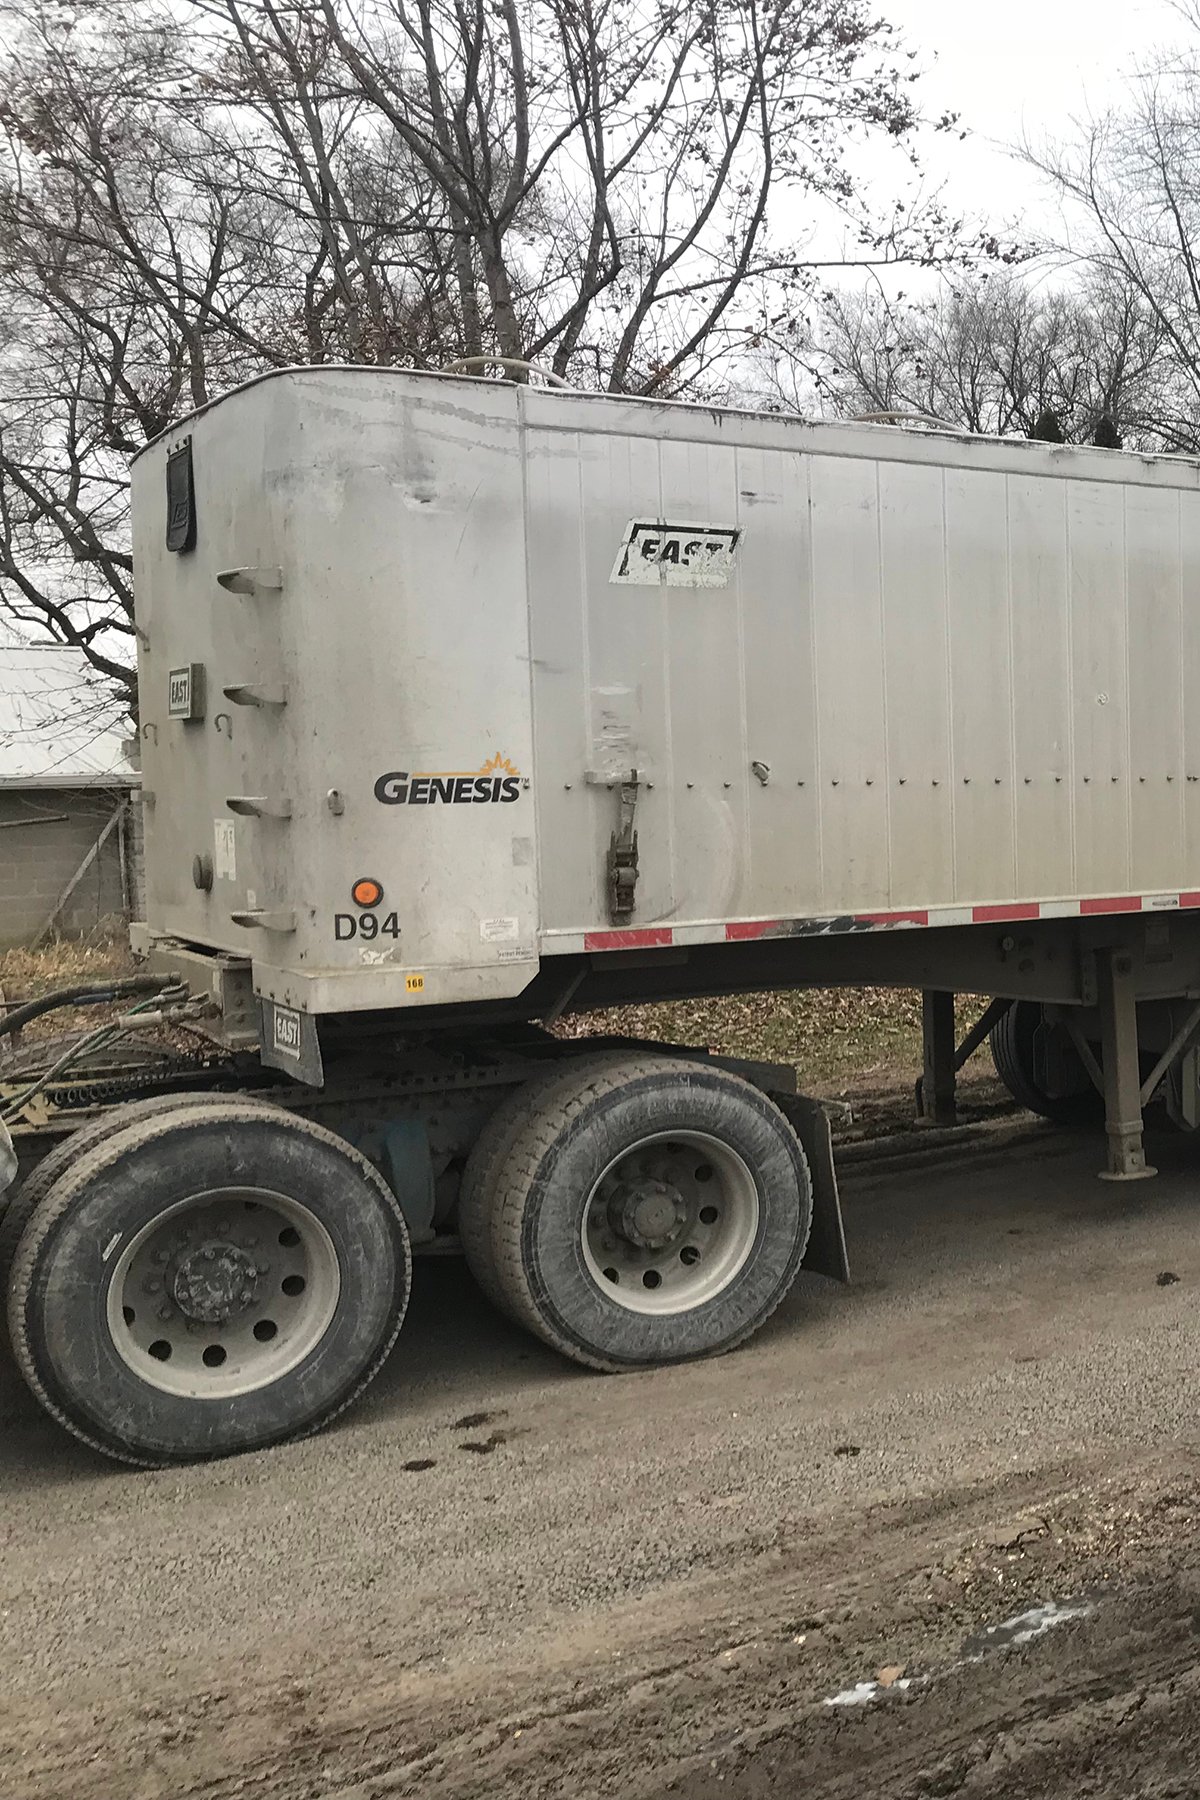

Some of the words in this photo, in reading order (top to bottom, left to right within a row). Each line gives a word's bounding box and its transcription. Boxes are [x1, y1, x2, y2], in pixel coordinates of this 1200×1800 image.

[171, 680, 188, 703] EAST
[374, 771, 520, 805] GENESIS
[334, 912, 401, 940] D94
[406, 978, 424, 989] 168
[277, 1017, 298, 1045] EAST
